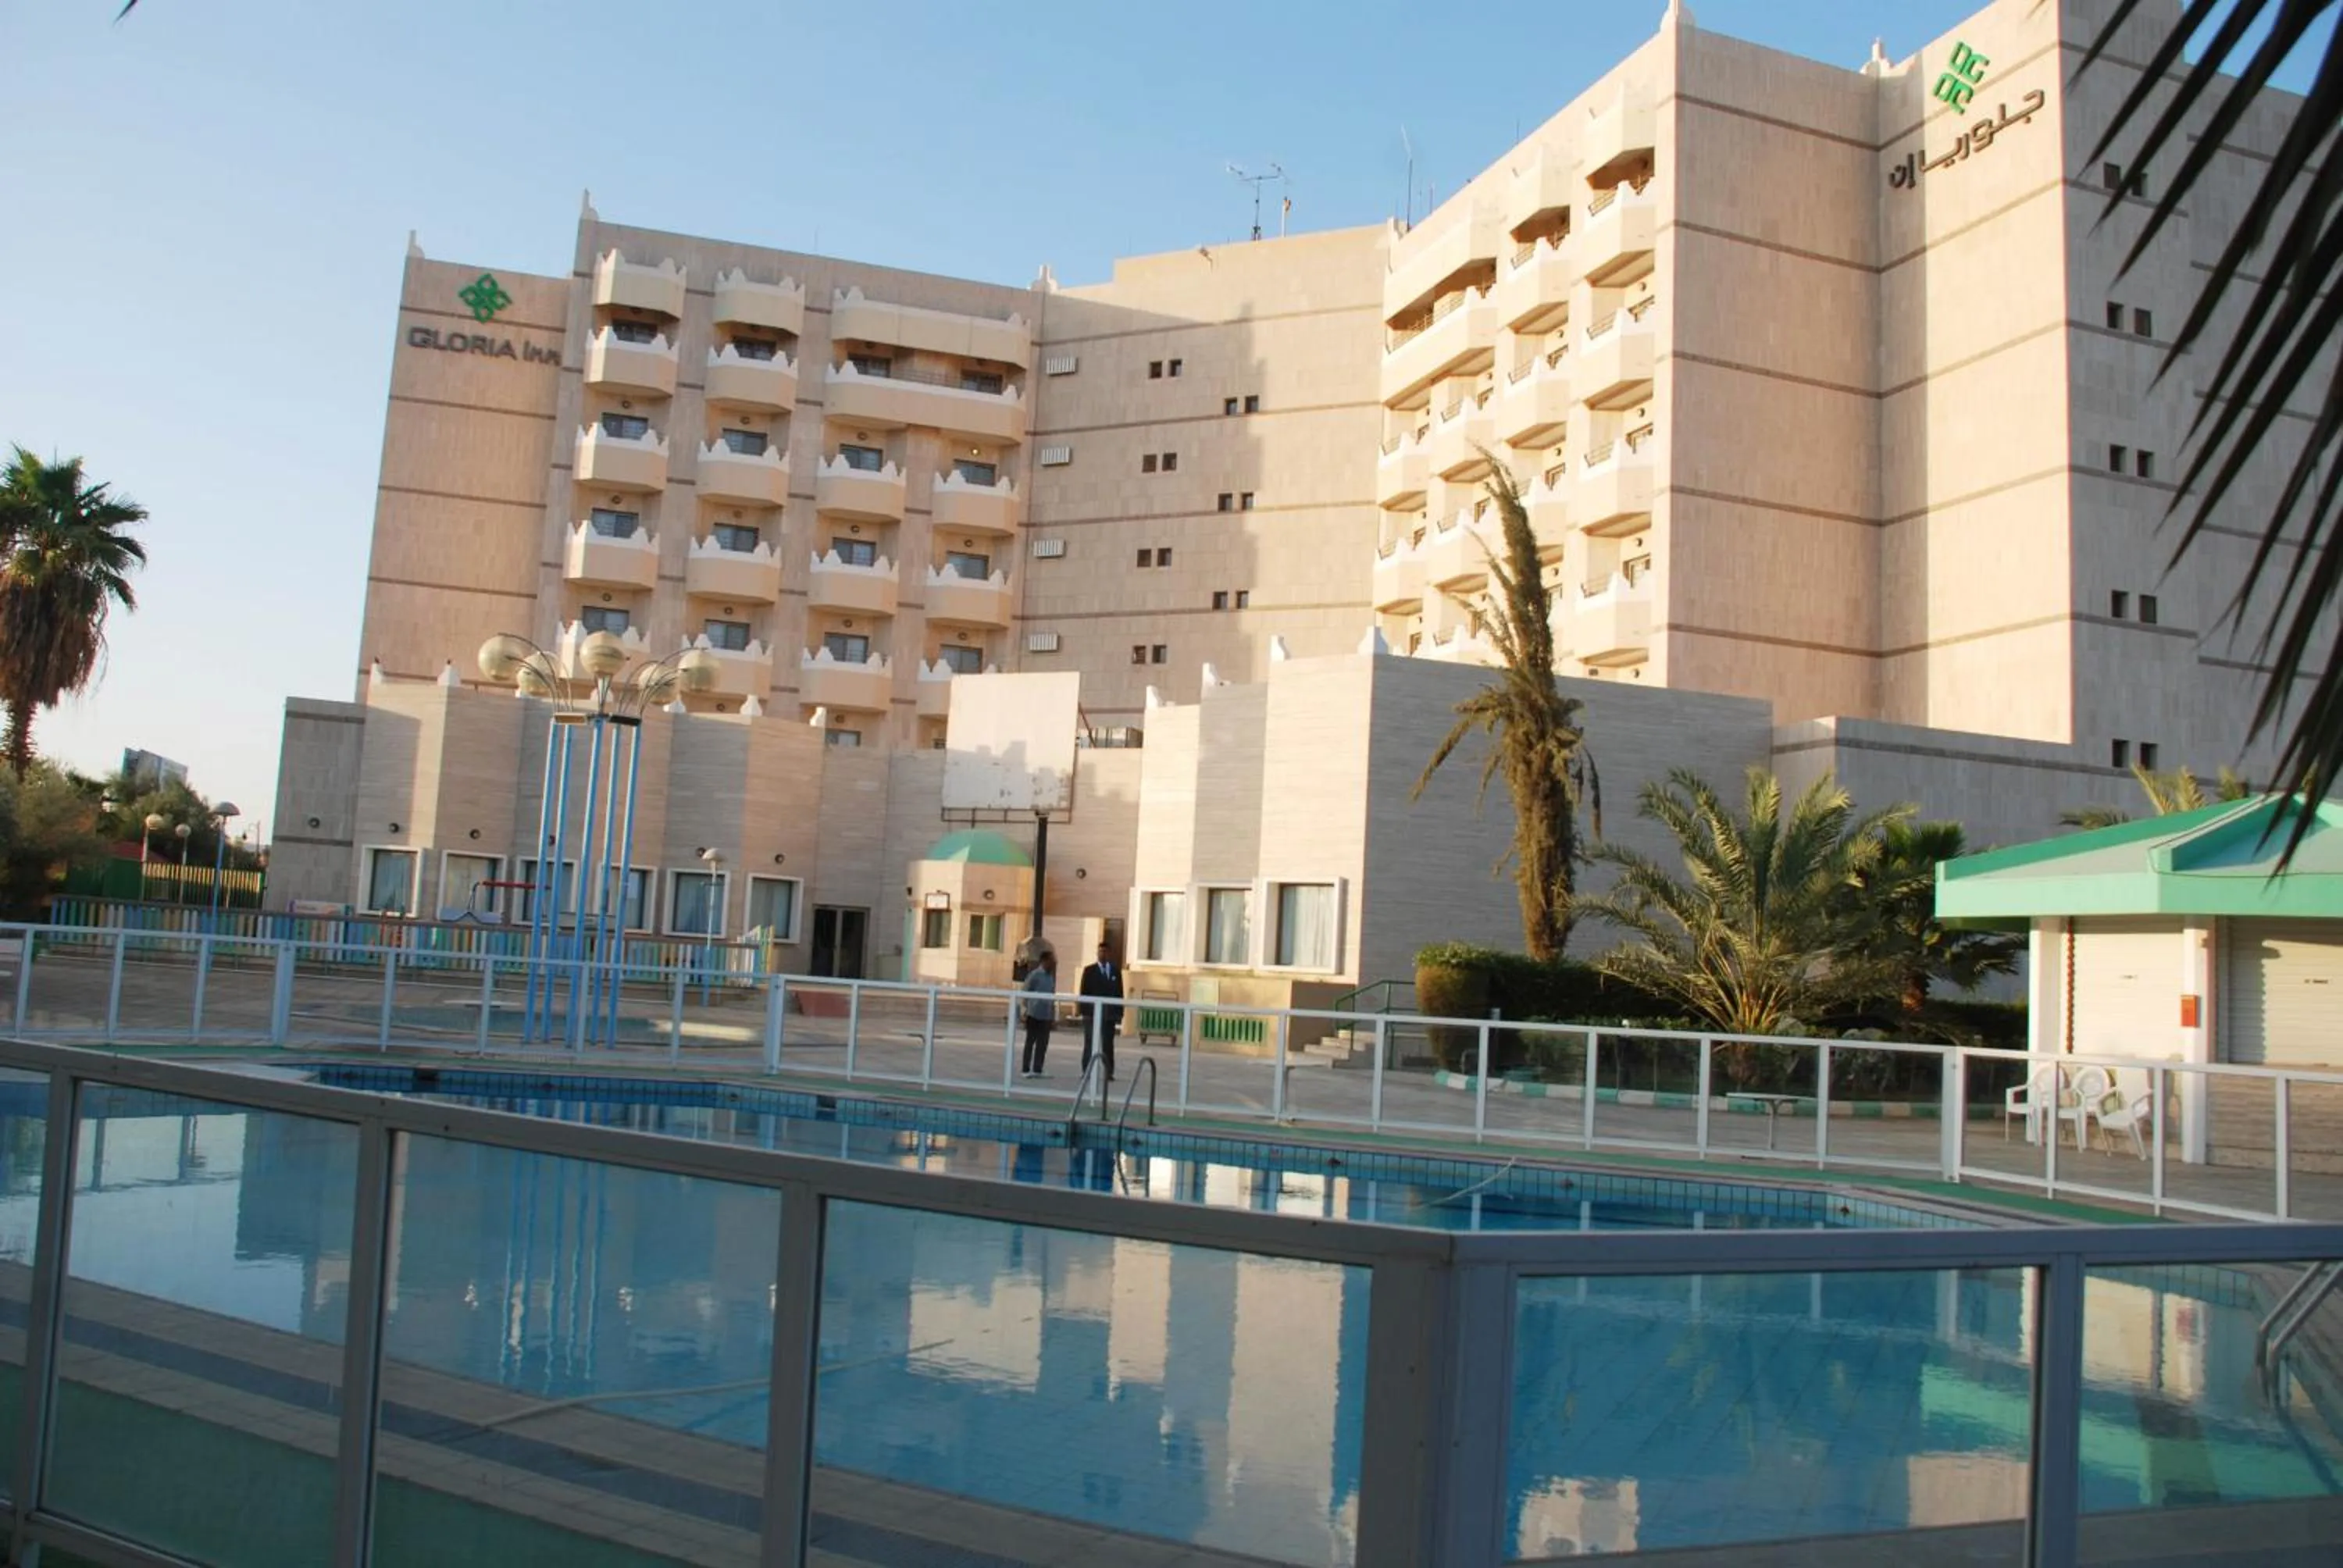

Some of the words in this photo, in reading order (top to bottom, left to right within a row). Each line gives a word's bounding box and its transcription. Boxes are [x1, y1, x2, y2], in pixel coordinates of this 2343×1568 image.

[1919, 90, 2045, 173] جلوريا
[407, 326, 517, 361] GLORIA
[522, 340, 562, 366] Inn
